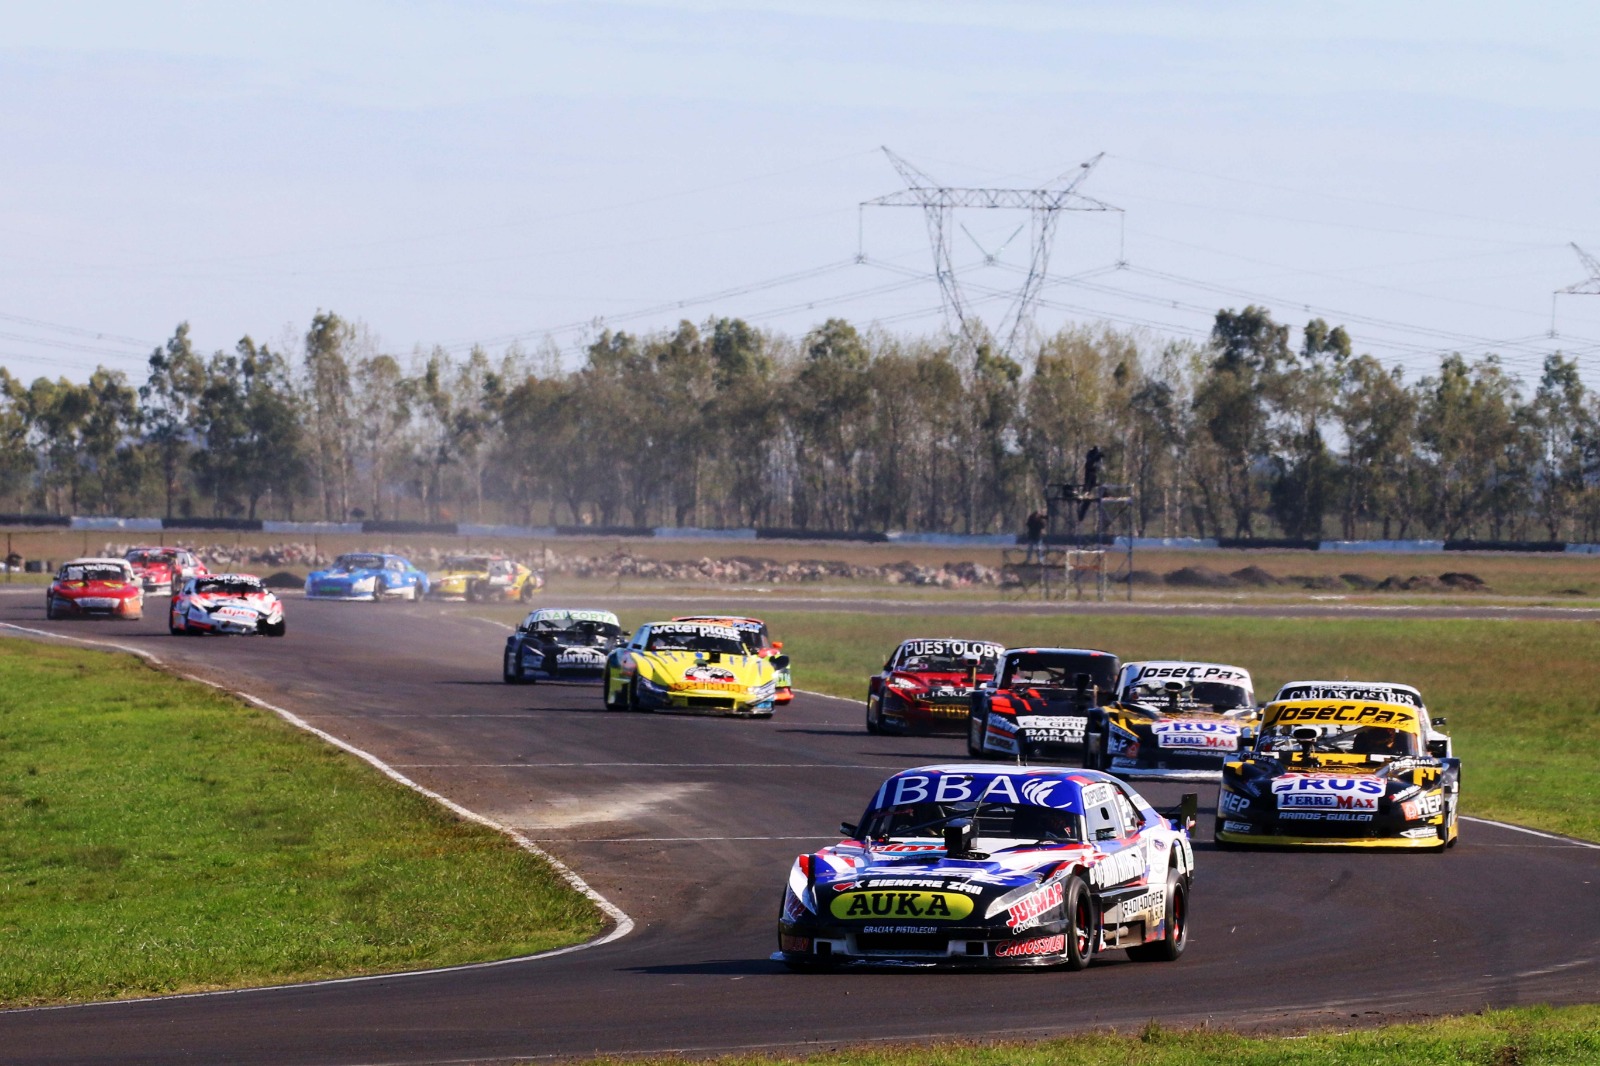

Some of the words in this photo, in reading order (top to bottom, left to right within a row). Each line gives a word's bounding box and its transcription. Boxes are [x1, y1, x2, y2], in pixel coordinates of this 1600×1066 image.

[1289, 690, 1347, 700] CARLOS
[1350, 691, 1414, 705] CASARES
[1173, 723, 1238, 734] RUS
[1298, 779, 1382, 794] RUS
[1223, 791, 1251, 813] HEP
[1413, 794, 1442, 815] HEP
[867, 879, 945, 889] SIEMPRE
[846, 893, 952, 917] AUKA
[1005, 881, 1064, 928] JULMAR
[863, 925, 894, 934] GRACIAS
